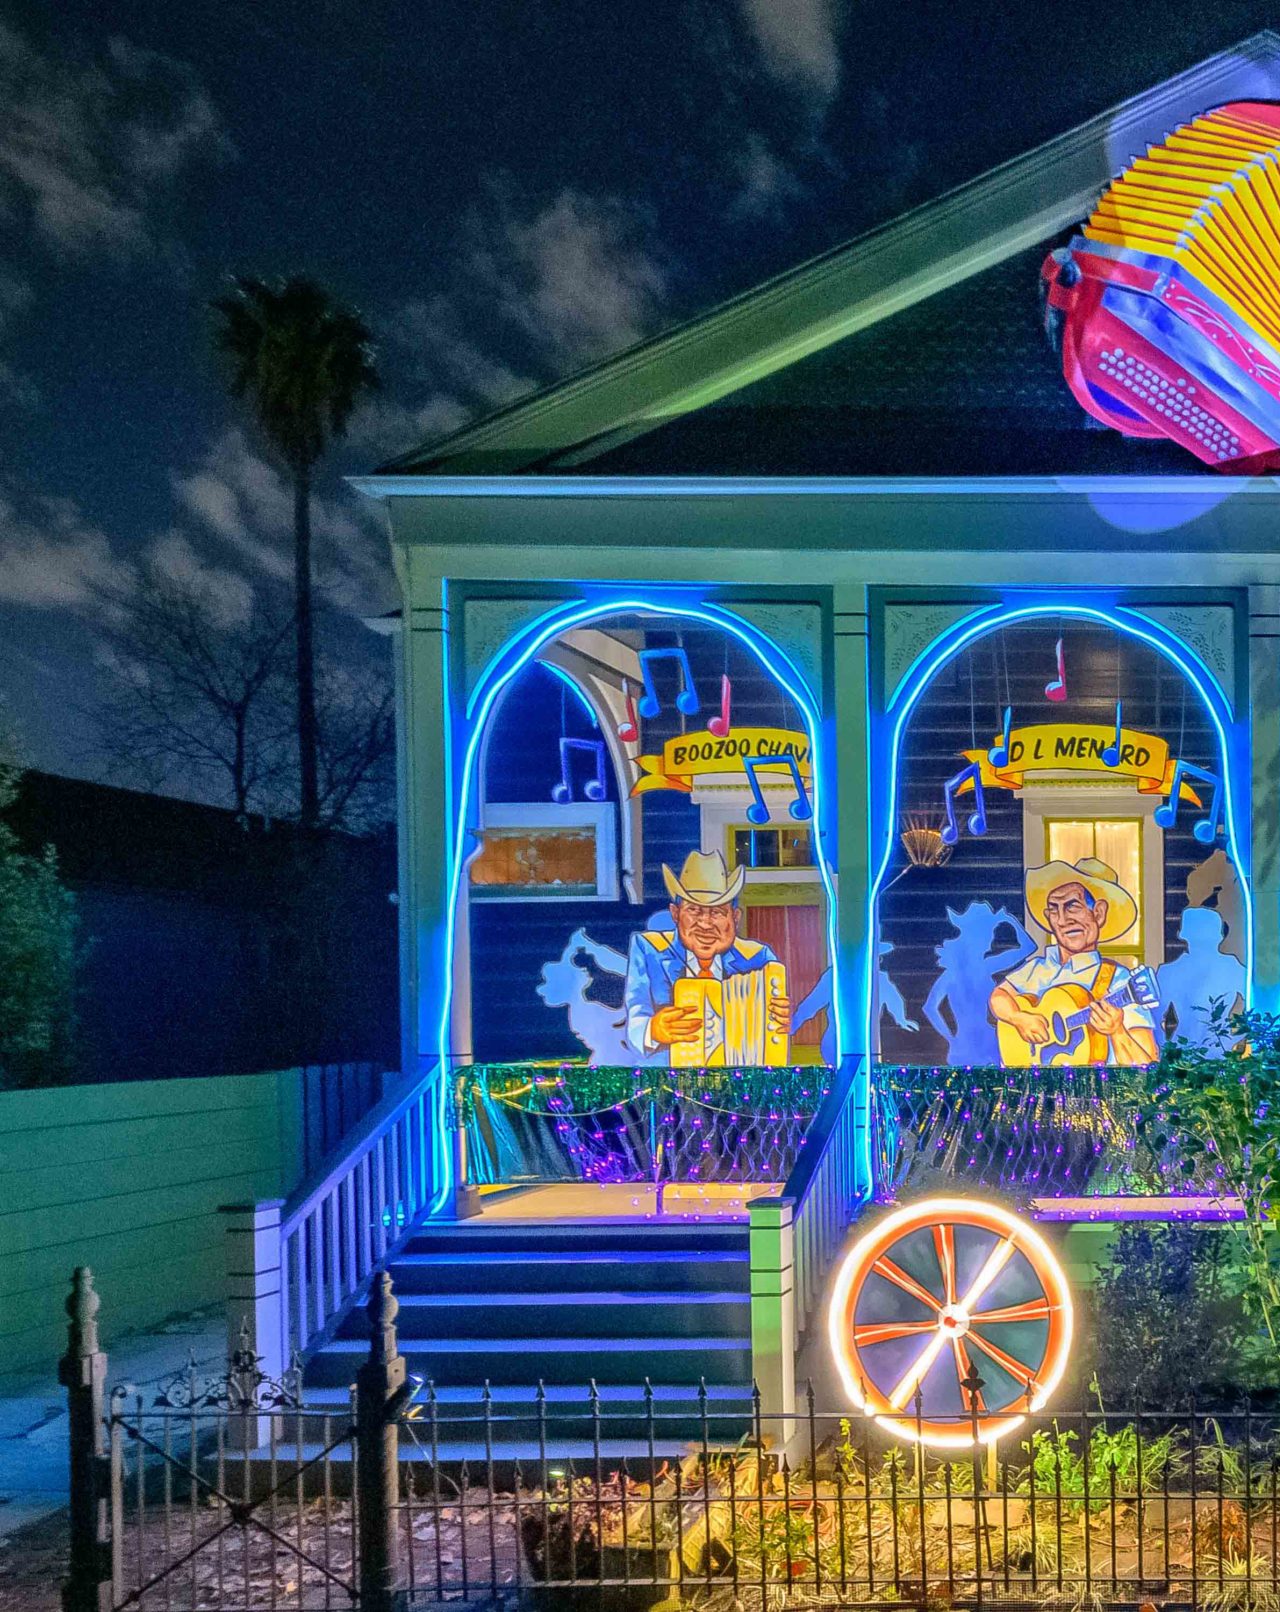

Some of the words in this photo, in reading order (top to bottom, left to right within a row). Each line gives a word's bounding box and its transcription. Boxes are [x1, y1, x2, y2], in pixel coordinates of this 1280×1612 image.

[674, 738, 750, 765] BOOZOO
[1010, 741, 1025, 763] D
[1033, 739, 1045, 759] L
[1054, 736, 1151, 767] MENRD
